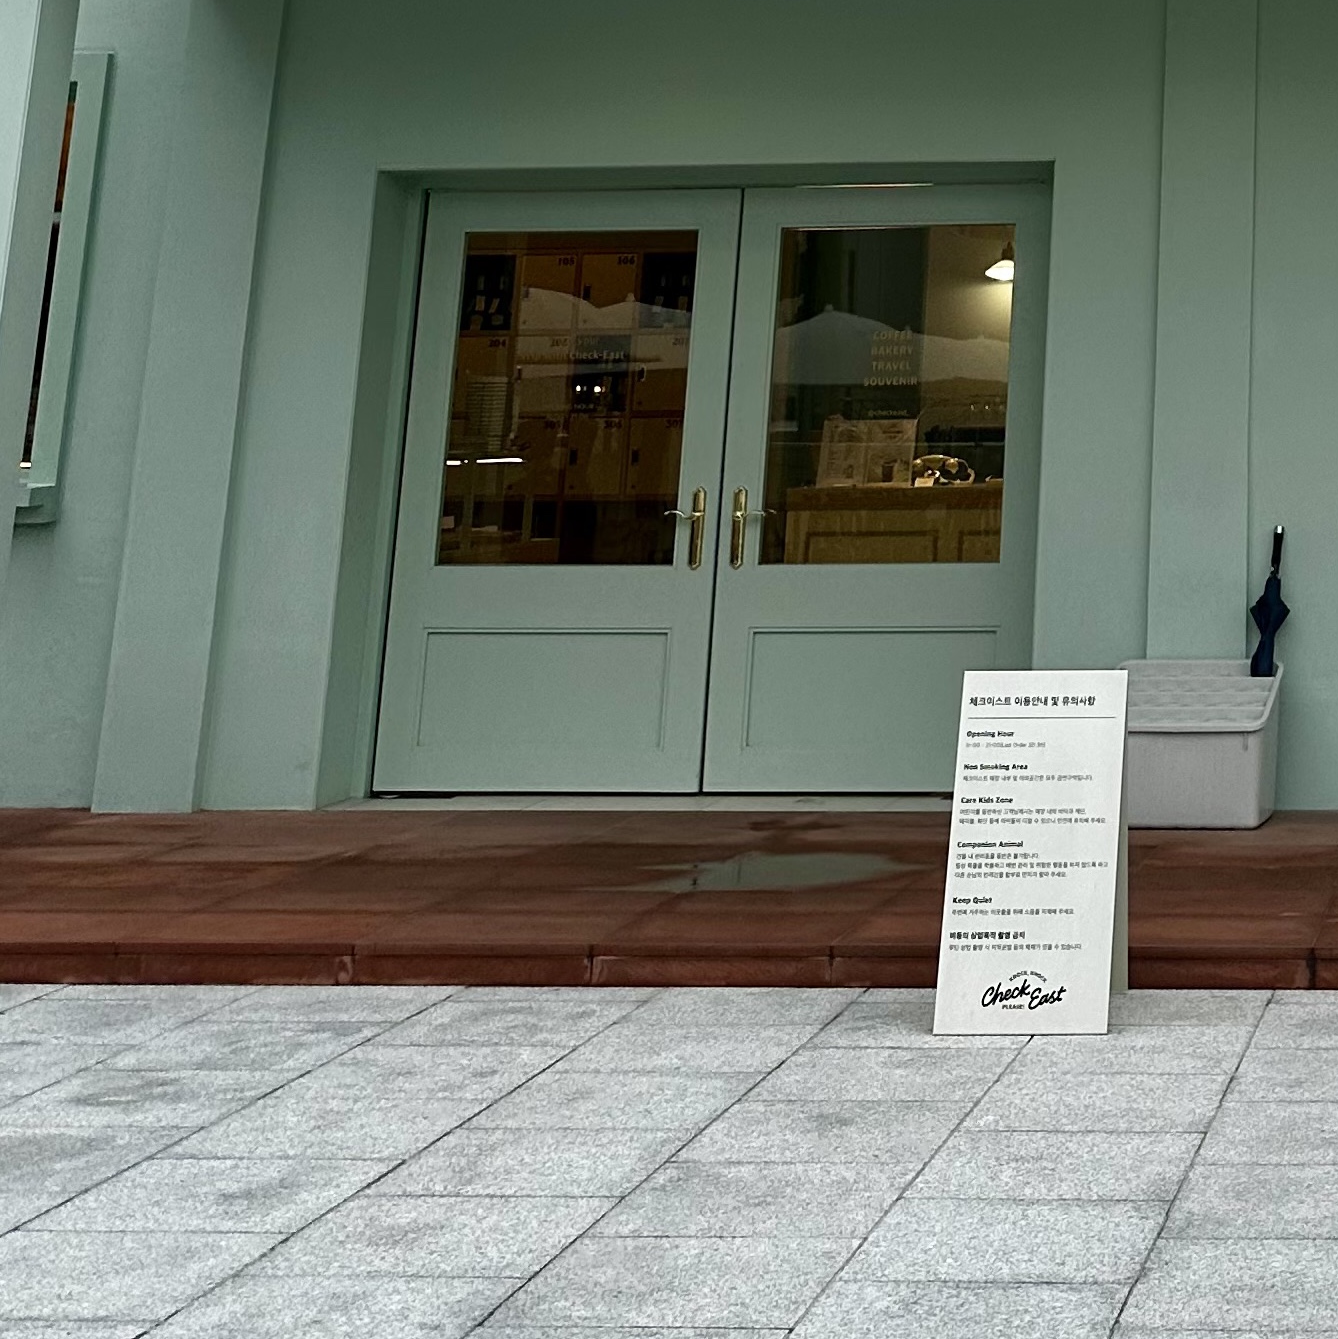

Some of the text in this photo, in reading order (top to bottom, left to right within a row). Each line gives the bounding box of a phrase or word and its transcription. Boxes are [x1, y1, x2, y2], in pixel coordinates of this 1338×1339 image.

[871, 345, 913, 355] BAKERY
[872, 361, 911, 371] TRAVEL
[864, 377, 918, 386] SOUVENIR
[969, 696, 1011, 707] 체크이스트
[1014, 696, 1048, 707] 이용안내
[1050, 696, 1059, 707] 및
[967, 730, 996, 738] Opening
[979, 763, 1010, 771] Smoking
[961, 796, 976, 804] Care
[952, 897, 971, 905] Keep
[981, 978, 1067, 1010] Check East
